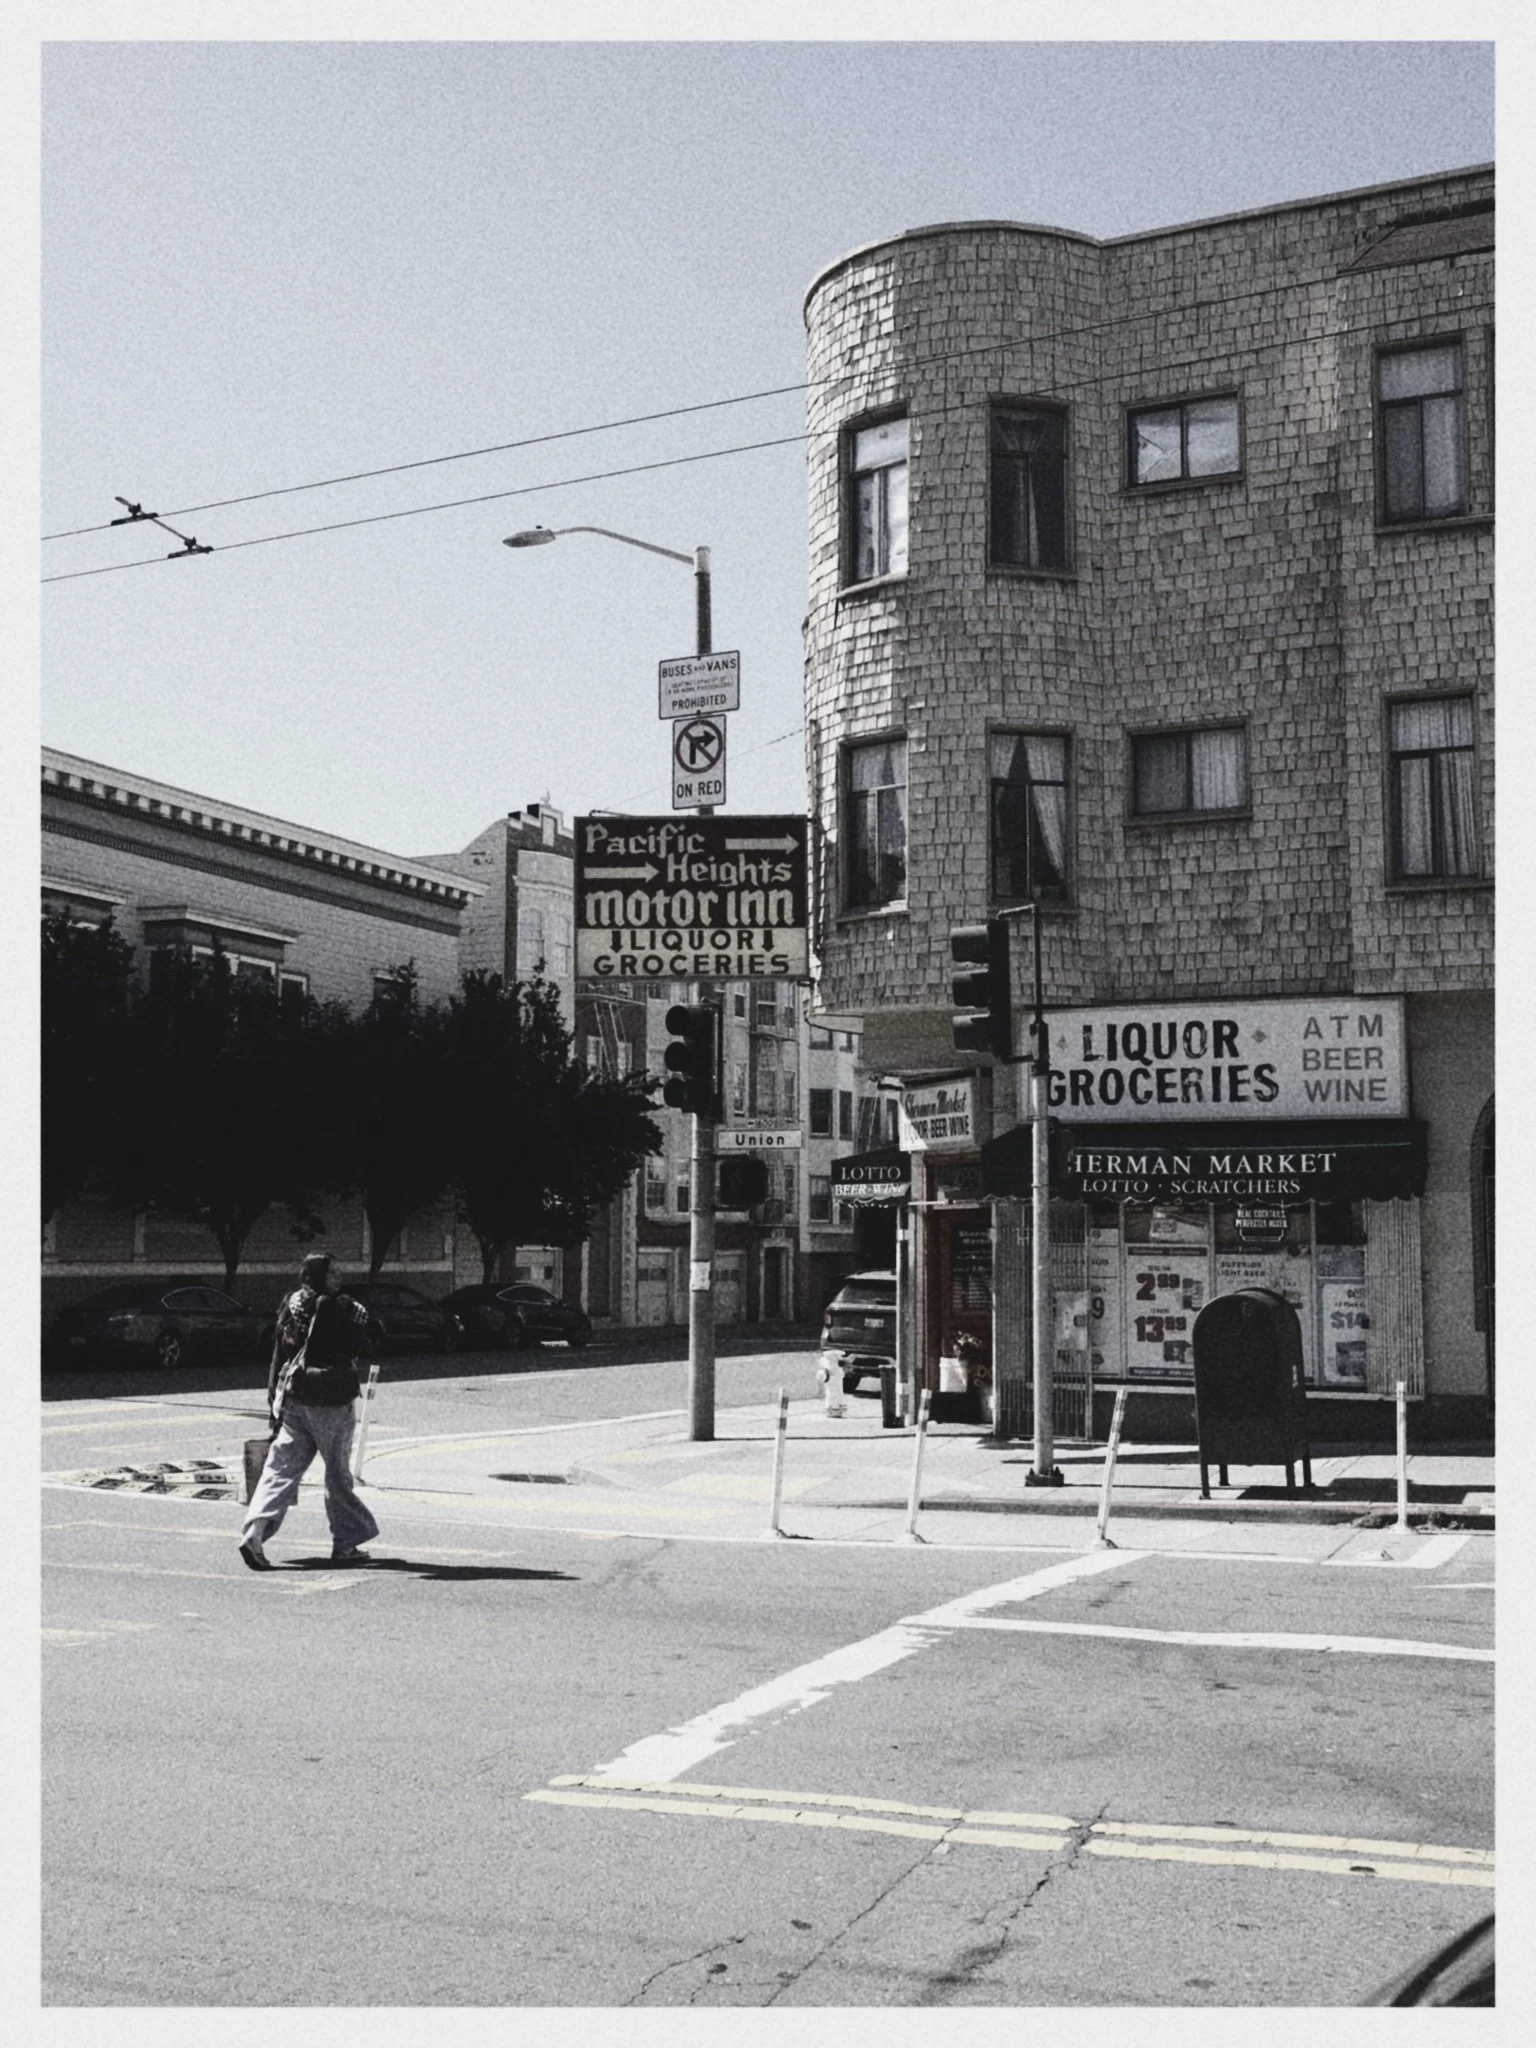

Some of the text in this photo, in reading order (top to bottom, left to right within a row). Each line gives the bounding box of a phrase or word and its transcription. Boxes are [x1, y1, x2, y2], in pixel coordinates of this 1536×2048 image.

[662, 664, 692, 678] BUSES
[706, 658, 737, 672] VANS
[672, 693, 727, 711] PROHIBITED
[676, 779, 722, 798] ON RED
[585, 823, 706, 859] Pacific
[666, 852, 793, 888] Heights
[629, 930, 755, 952] LIQUOR
[593, 954, 790, 976] GROCERIES
[1302, 1014, 1384, 1041] ATM
[1082, 1020, 1240, 1066] LIQUOR
[1302, 1046, 1384, 1072] BEER
[1047, 1063, 1280, 1106] GROCERIES
[1303, 1078, 1387, 1103] WINE
[949, 1115, 970, 1136] WINE
[735, 1133, 785, 1146] Union
[841, 1166, 901, 1180] LOTTO
[1208, 1152, 1337, 1173] MARKET
[834, 1184, 867, 1197] BEER
[1081, 1179, 1301, 1195] LOTTO SCRATCHERS
[1220, 1261, 1262, 1269] SUPERIOR
